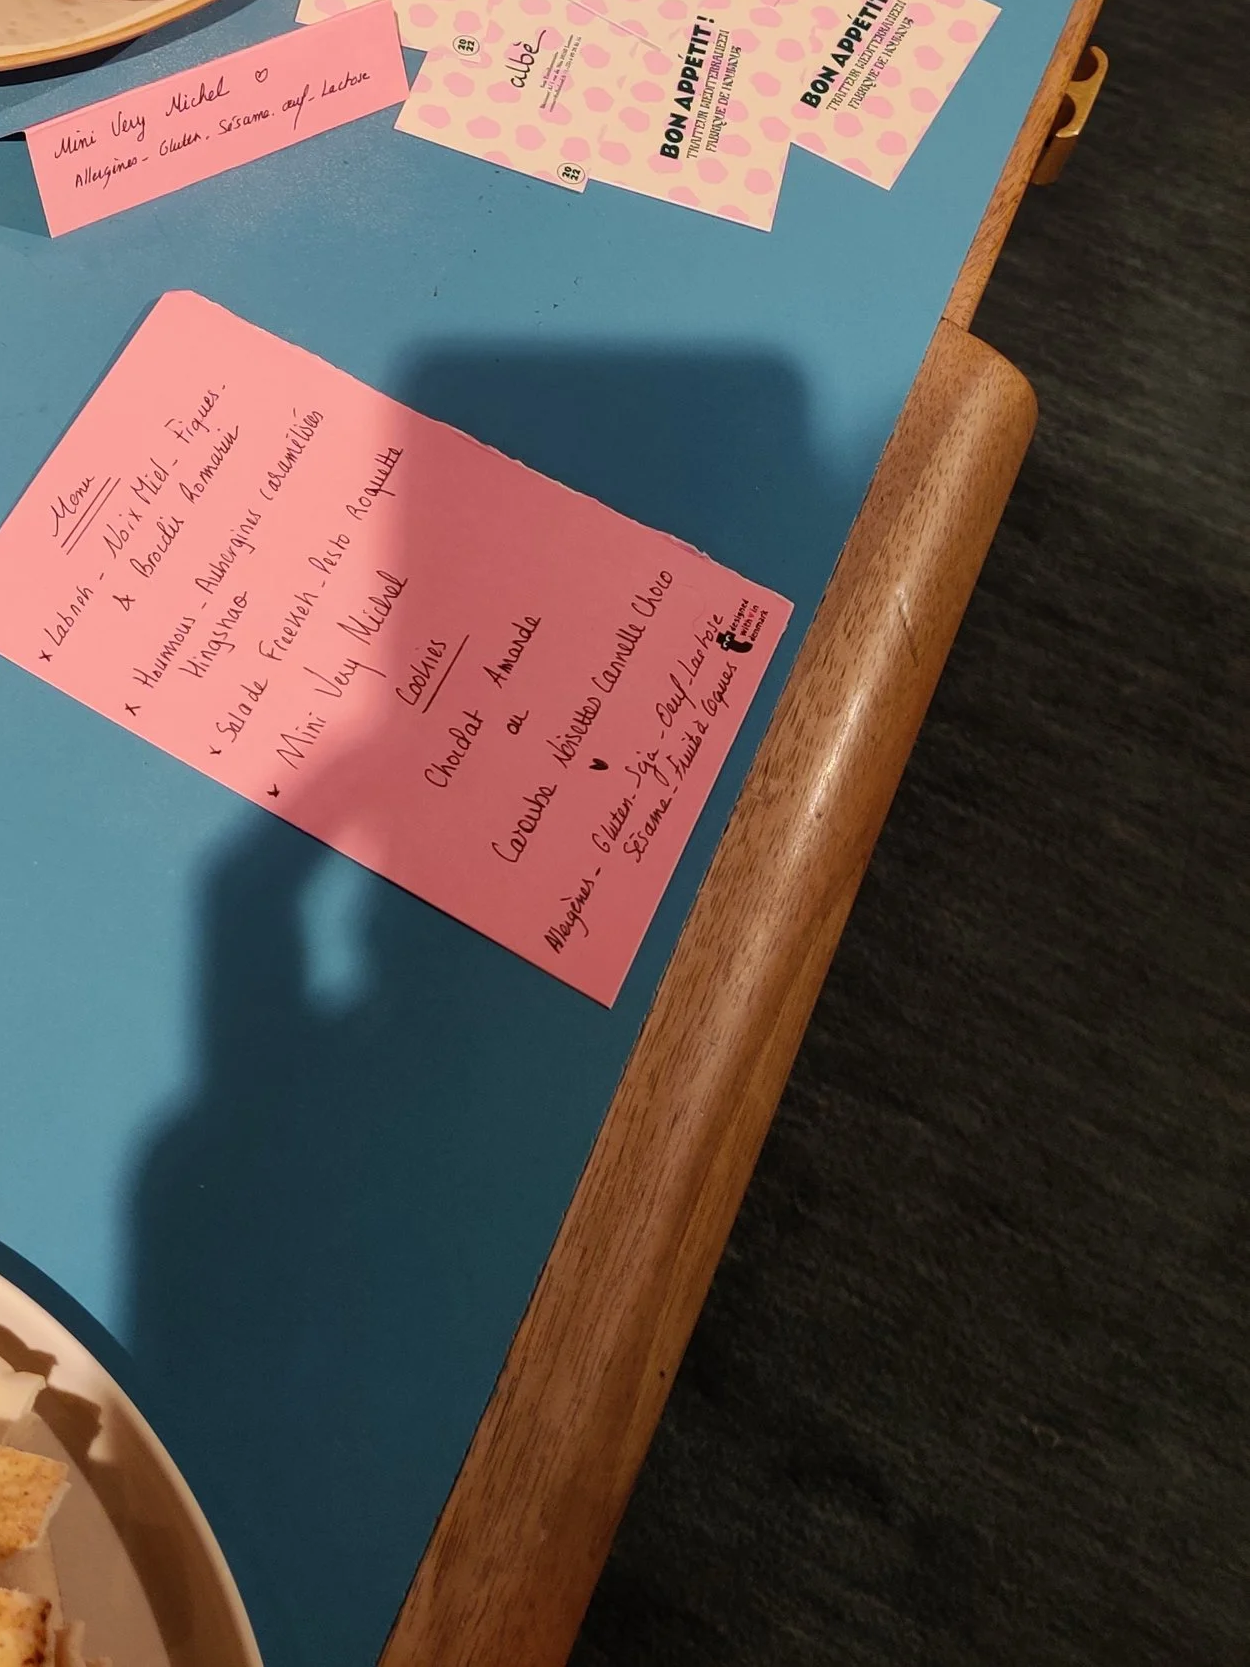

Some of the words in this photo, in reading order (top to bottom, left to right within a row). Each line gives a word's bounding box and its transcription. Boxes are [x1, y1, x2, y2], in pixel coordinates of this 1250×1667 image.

[673, 24, 712, 112] APPÉTIT
[799, 65, 840, 109] BON
[54, 134, 97, 159] Mini
[111, 111, 146, 142] Very
[165, 76, 231, 117] Michel
[659, 112, 688, 160] BON
[181, 425, 239, 504] Romarin
[52, 475, 95, 538] Menu
[103, 510, 143, 559] Noix
[130, 457, 171, 505] Miel
[194, 508, 262, 596] Aubergines
[217, 679, 268, 743] Salade
[307, 532, 351, 577] Pesto
[345, 445, 405, 521] Roquette
[335, 569, 410, 646] Michel
[729, 597, 749, 632] designed
[740, 618, 754, 637] with
[748, 609, 769, 642] denmark
[302, 657, 387, 699] Very
[394, 637, 448, 707] Cookies
[482, 615, 542, 690] Amande
[275, 711, 327, 771] Mini
[491, 783, 558, 864] Caroube
[590, 622, 647, 695] Cannelle
[506, 709, 529, 736] ou
